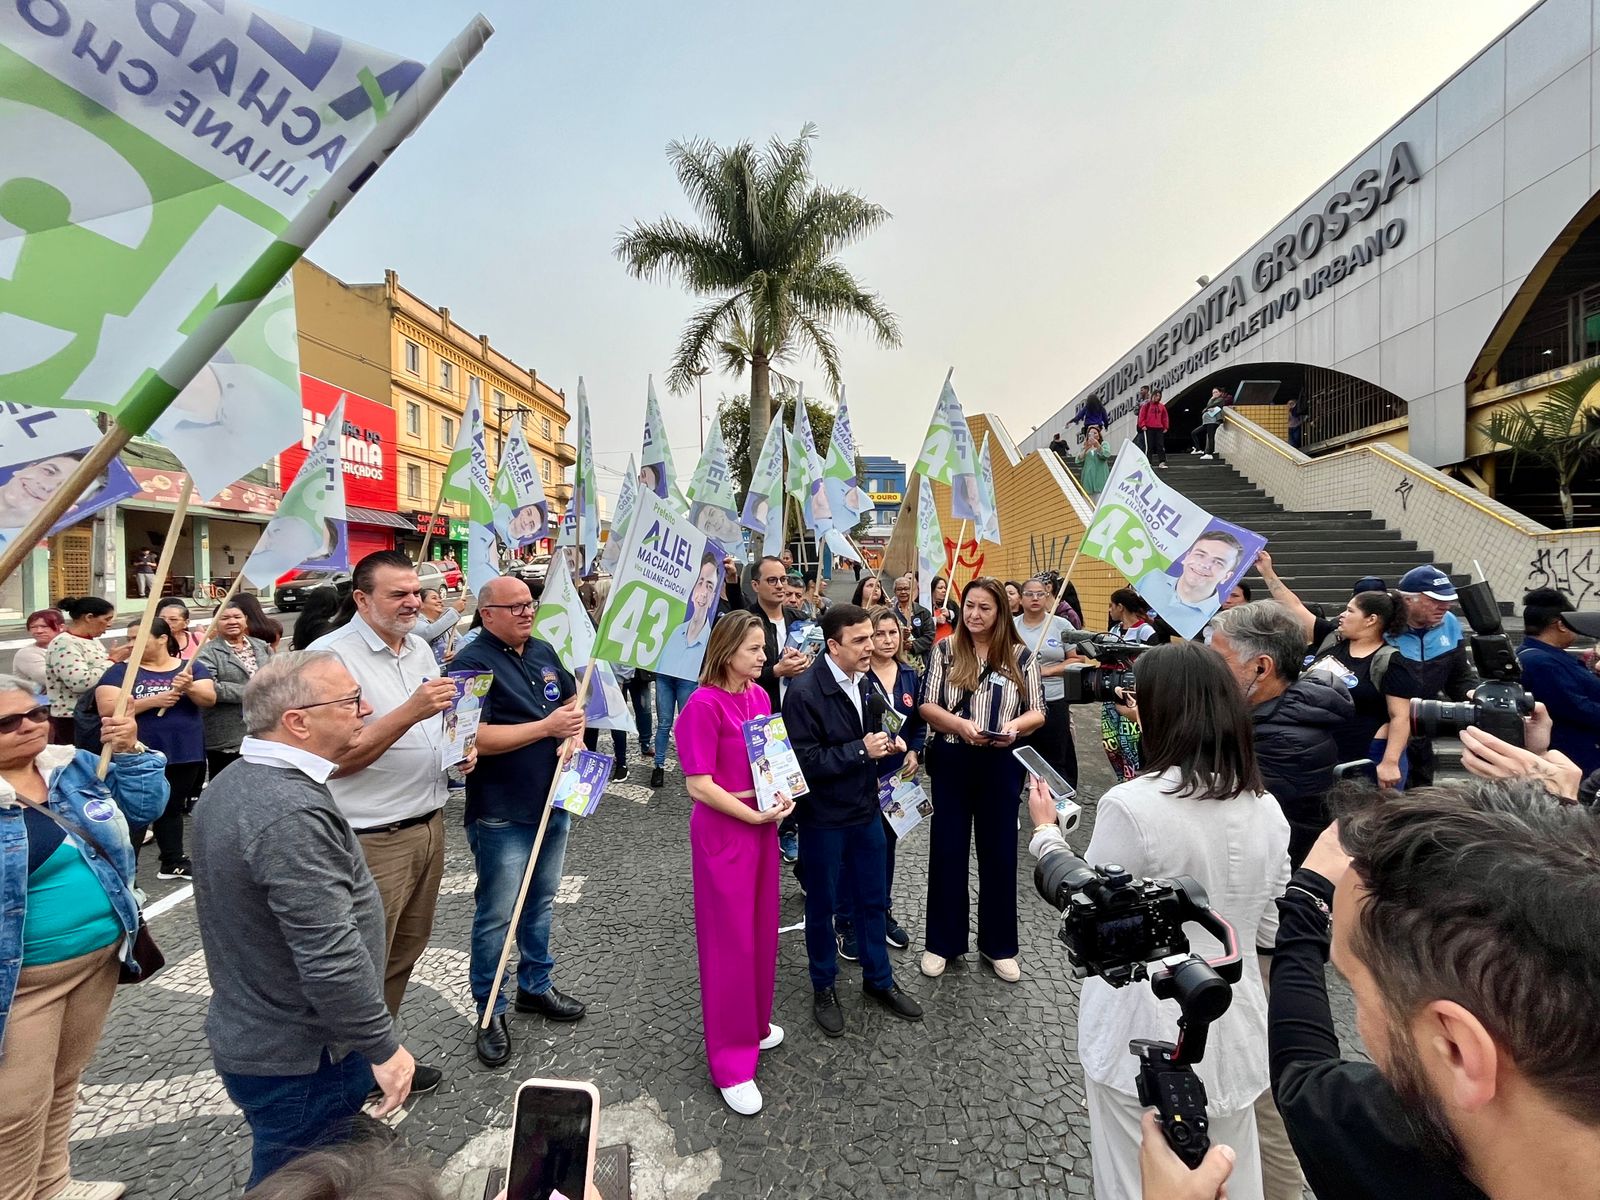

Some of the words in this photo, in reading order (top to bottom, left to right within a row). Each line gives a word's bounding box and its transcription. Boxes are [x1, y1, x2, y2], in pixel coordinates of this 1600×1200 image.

[1146, 332, 1169, 373] DE
[1171, 275, 1247, 355] PONTA
[1251, 141, 1420, 293] GROSSA
[1107, 397, 1136, 426] ENTRAL
[1221, 287, 1300, 353] COLETIVO
[1302, 217, 1406, 300] URBANO
[508, 437, 534, 495] ALIEL
[653, 502, 676, 525] Prefeito
[1124, 470, 1183, 538] ALIEL
[637, 546, 681, 579] MACHADO
[642, 519, 694, 573] ALIEL
[1087, 508, 1152, 576] 43
[642, 567, 665, 585] LILIANE
[608, 586, 670, 666] 43
[474, 678, 491, 692] 43
[772, 722, 786, 735] 43
